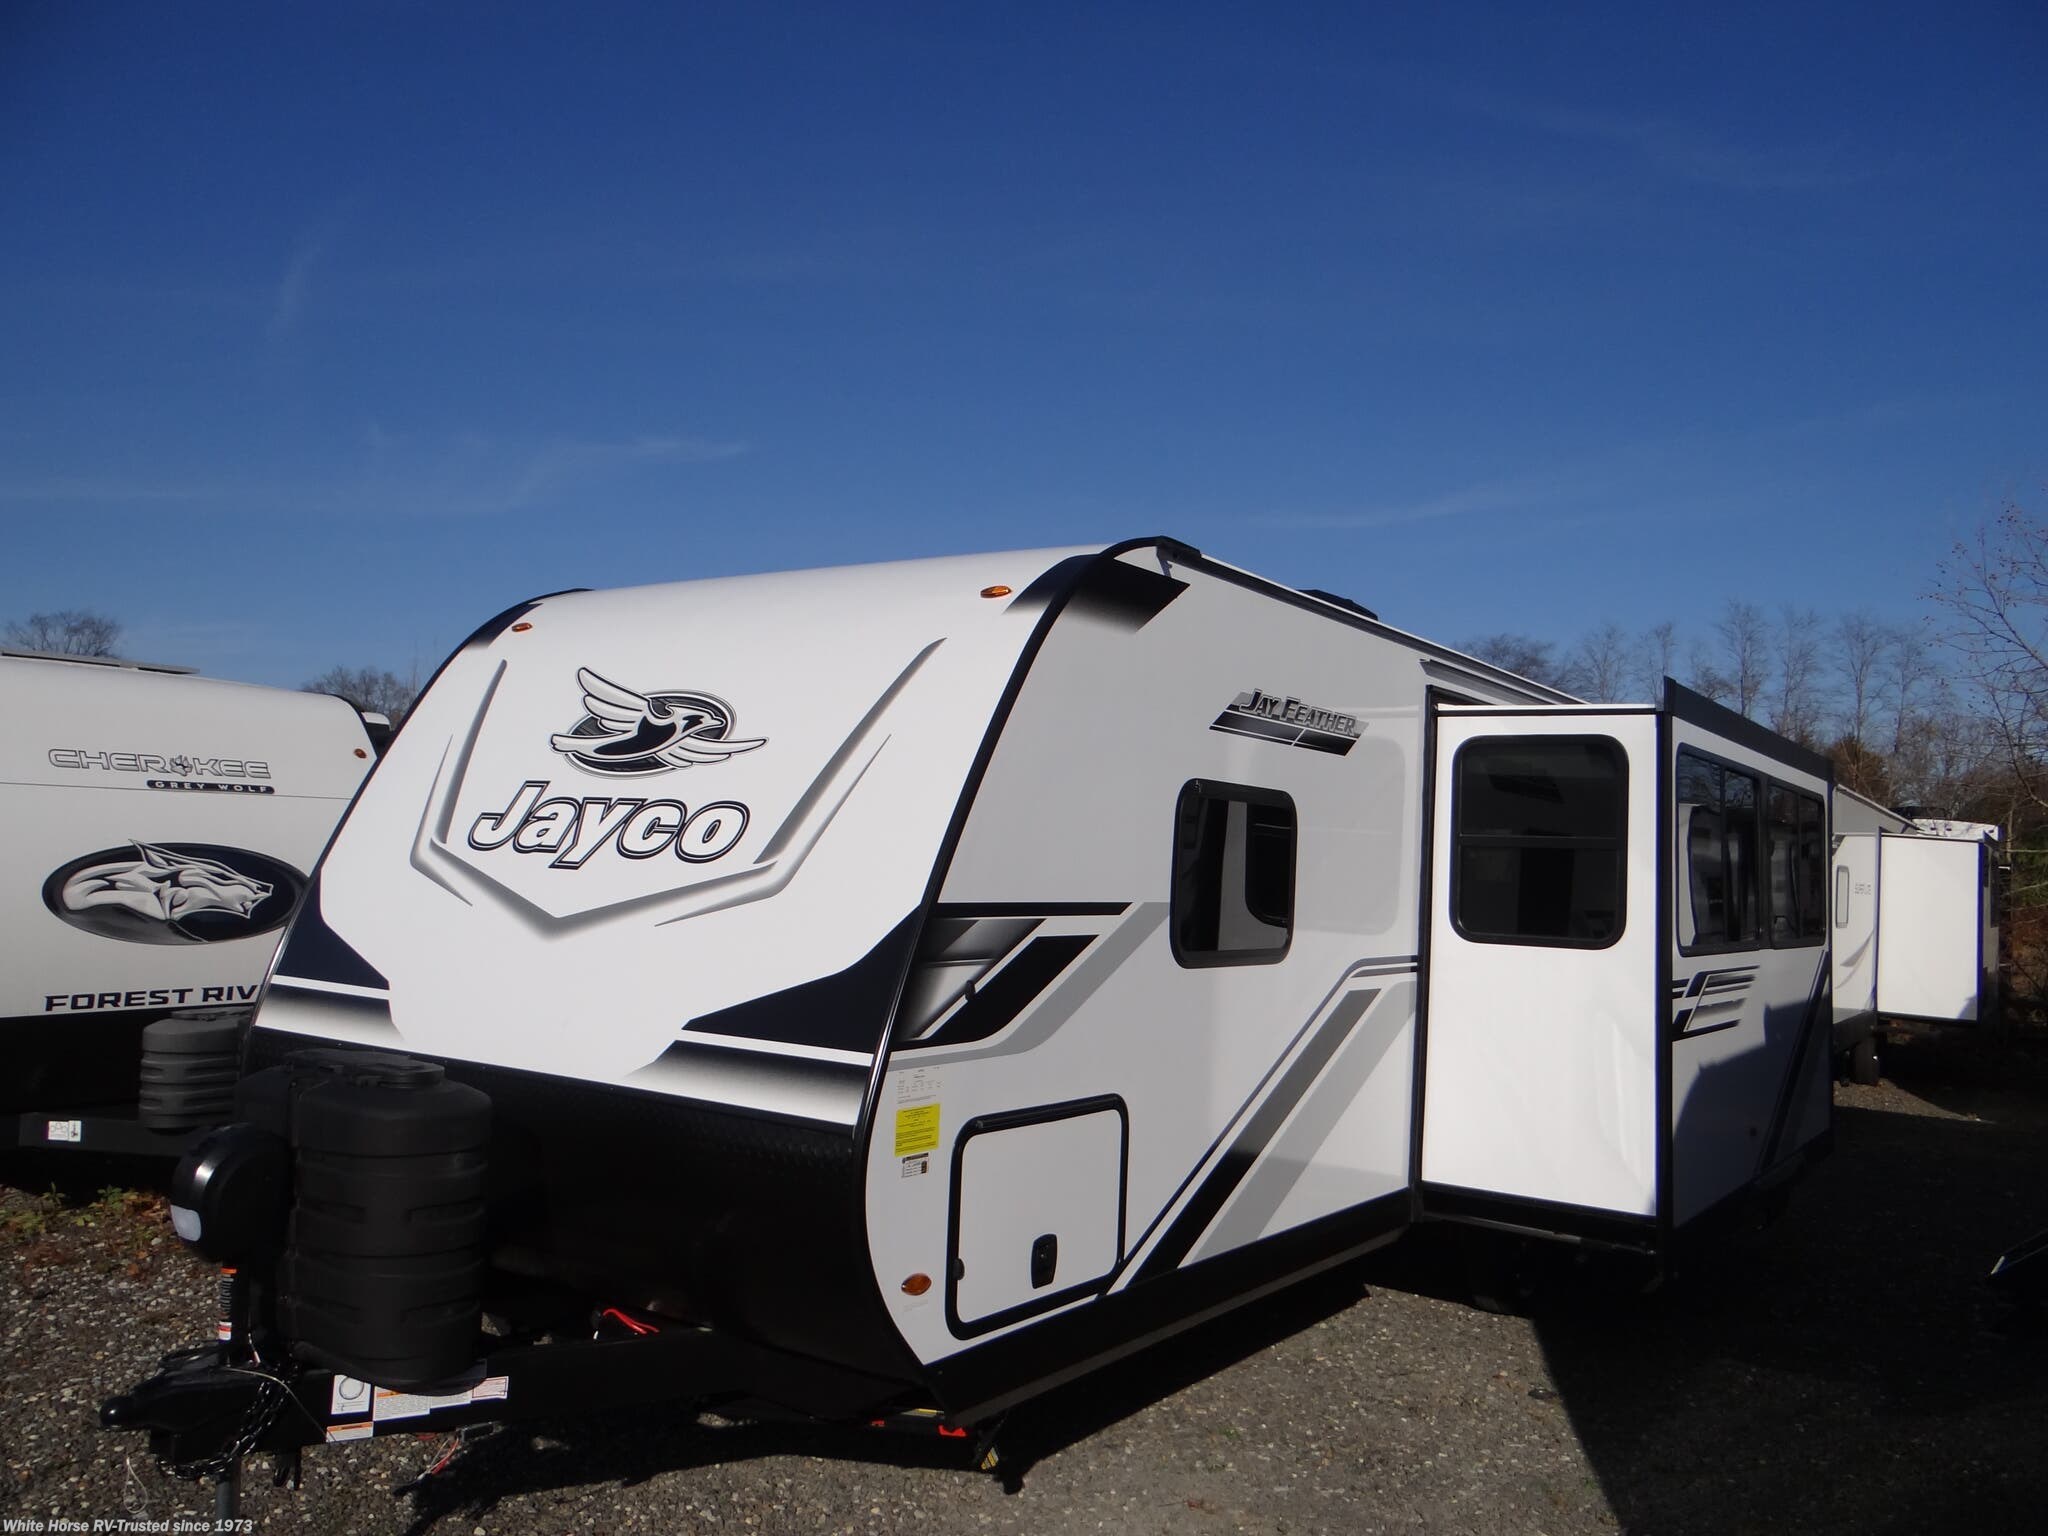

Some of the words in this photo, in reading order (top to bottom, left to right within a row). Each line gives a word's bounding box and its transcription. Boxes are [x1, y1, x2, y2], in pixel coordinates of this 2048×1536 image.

[154, 781, 204, 790] GREY
[218, 784, 267, 793] WOLF
[467, 780, 751, 870] Jayco
[45, 988, 193, 1011] FOREST
[202, 984, 259, 1002] RIV
